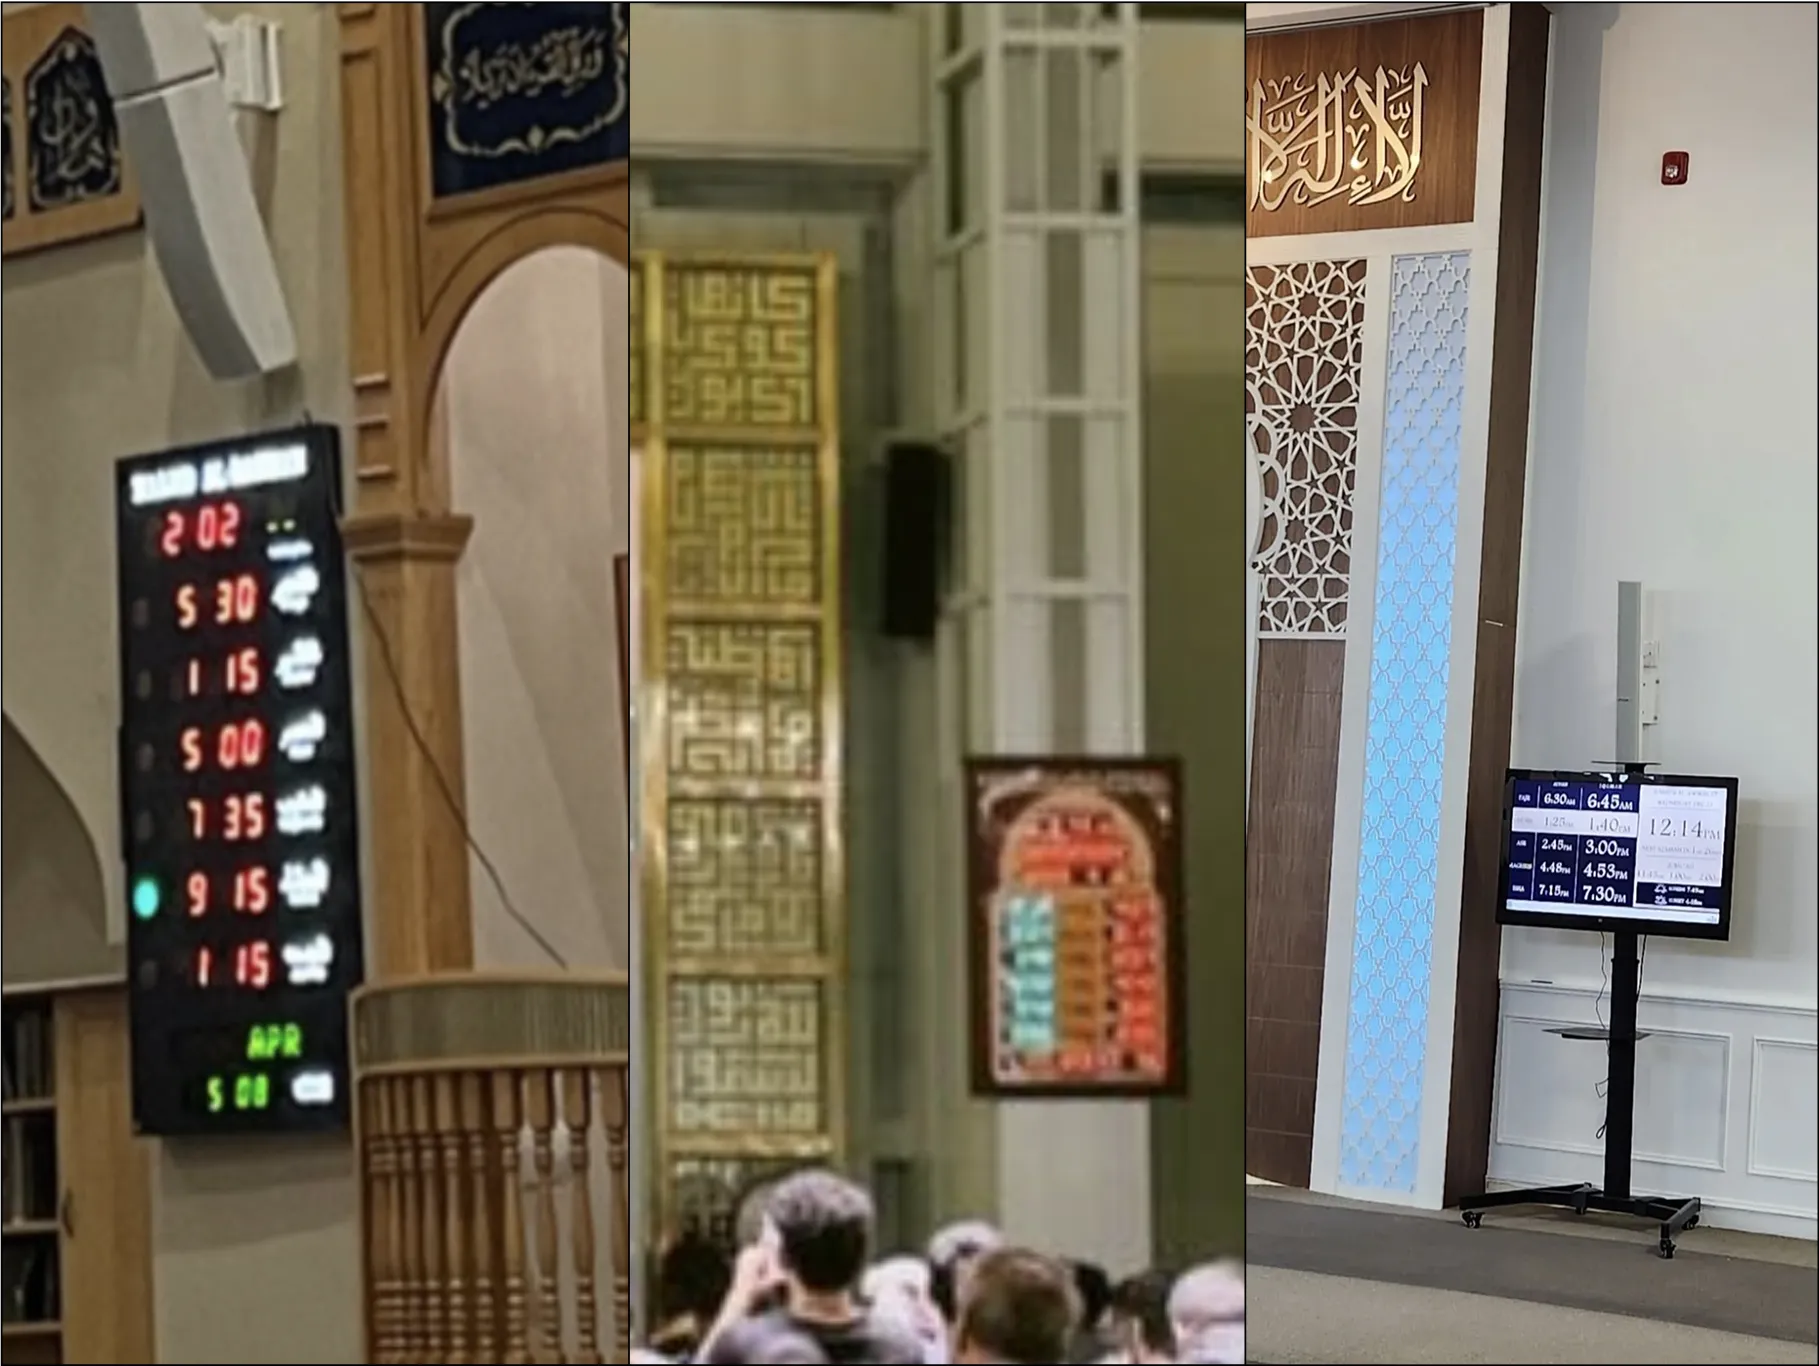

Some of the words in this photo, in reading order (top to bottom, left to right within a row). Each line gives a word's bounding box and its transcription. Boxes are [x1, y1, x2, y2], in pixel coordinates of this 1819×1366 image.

[215, 575, 257, 624] 30
[227, 648, 259, 694] 15
[219, 719, 263, 769] 00
[223, 794, 264, 840] 35
[188, 872, 208, 916] 9
[234, 867, 268, 914] 15
[236, 941, 270, 989] 15
[247, 1023, 302, 1059] APR
